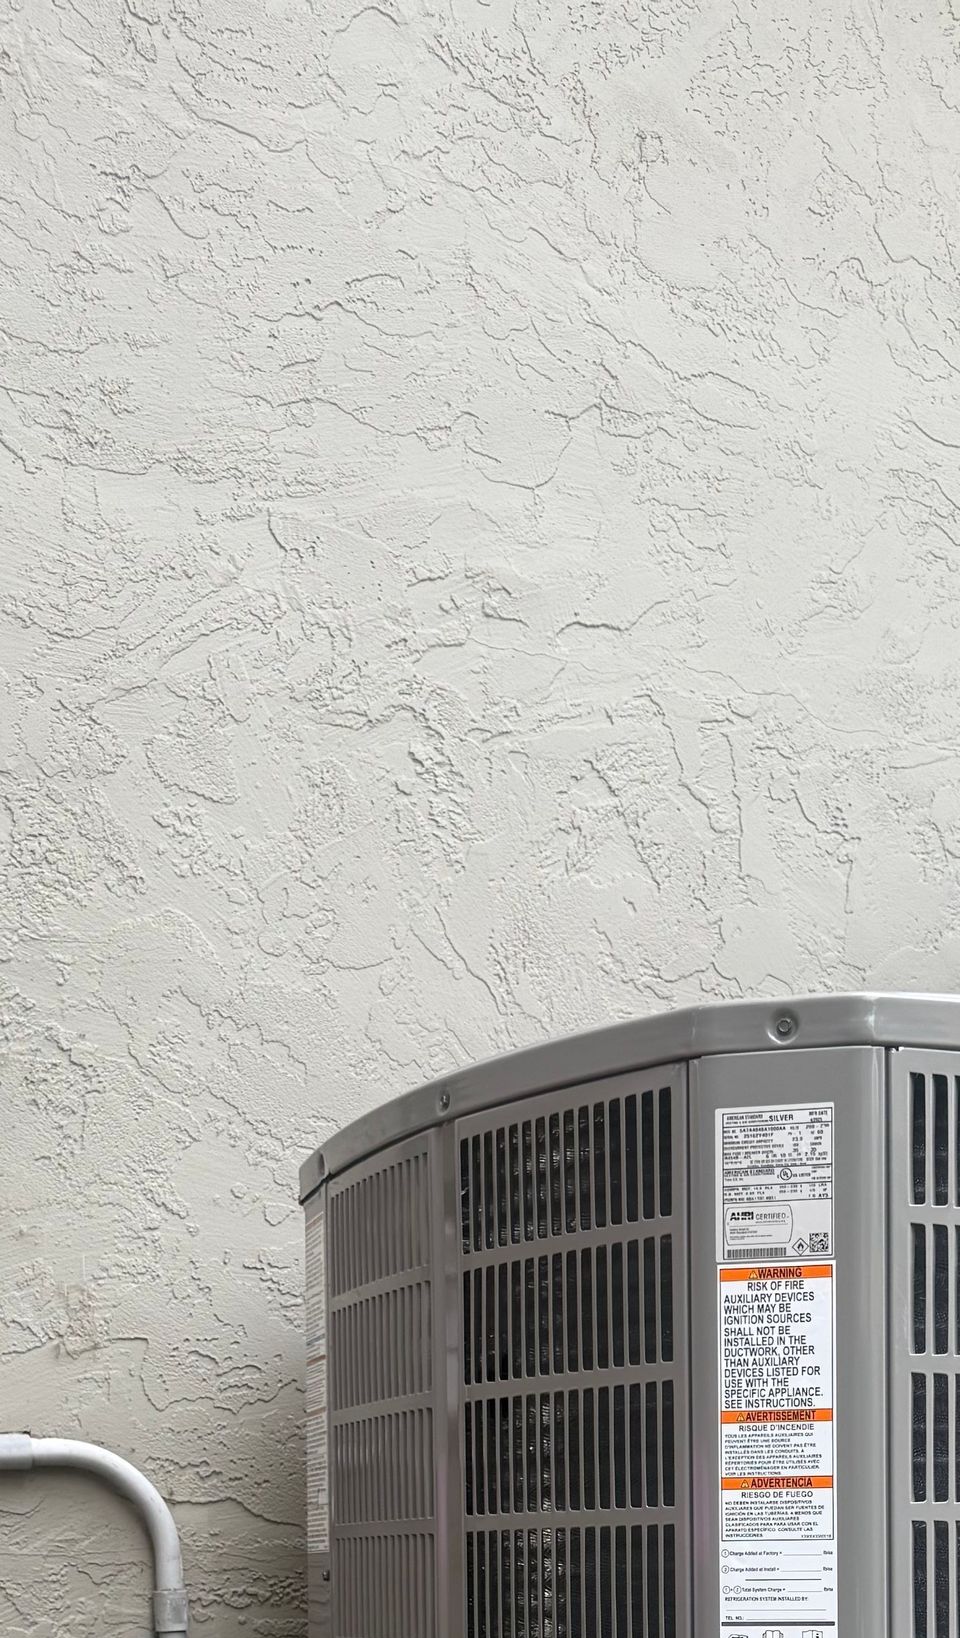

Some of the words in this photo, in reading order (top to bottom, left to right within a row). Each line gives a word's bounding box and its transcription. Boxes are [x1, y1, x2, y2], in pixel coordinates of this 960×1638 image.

[768, 1113, 794, 1122] SILVER
[730, 1211, 754, 1221] AHRI
[755, 1212, 786, 1221] CERTIFIED
[758, 1268, 802, 1279] WARNING
[748, 1282, 767, 1291] RISK
[770, 1281, 782, 1290] OF
[785, 1280, 804, 1289] FIRE
[724, 1293, 772, 1304] AUXILIARY
[775, 1292, 814, 1302] DEVICES
[724, 1305, 754, 1314] WHICH
[757, 1304, 776, 1313] MAY
[779, 1303, 791, 1312] BE
[724, 1315, 764, 1325] IGNITION
[767, 1313, 812, 1323] SOURCES
[724, 1327, 753, 1336] SHALL
[757, 1326, 775, 1335] NOT
[779, 1326, 790, 1335] BE
[724, 1337, 774, 1347] INSTALLED
[777, 1336, 785, 1345] IN
[788, 1336, 806, 1344] THE
[724, 1347, 780, 1357] DUCTWORK,
[783, 1346, 815, 1355] OTHER
[725, 1359, 749, 1367] THAN
[752, 1357, 800, 1367] AUXILIARY
[725, 1368, 763, 1378] DEVICES
[767, 1367, 798, 1377] LISTED
[802, 1366, 820, 1375] FOR
[725, 1379, 742, 1388] USE
[745, 1378, 768, 1387] WITH
[771, 1378, 789, 1386] THE
[725, 1389, 766, 1398] SPECIFIC
[768, 1387, 823, 1397] APPLIANCE.
[725, 1400, 742, 1408] SEE
[745, 1398, 815, 1408] INSTRUCTIONS.
[746, 1411, 816, 1422] AVERTISSEMENT
[751, 1478, 813, 1488] ADVERTENCIA
